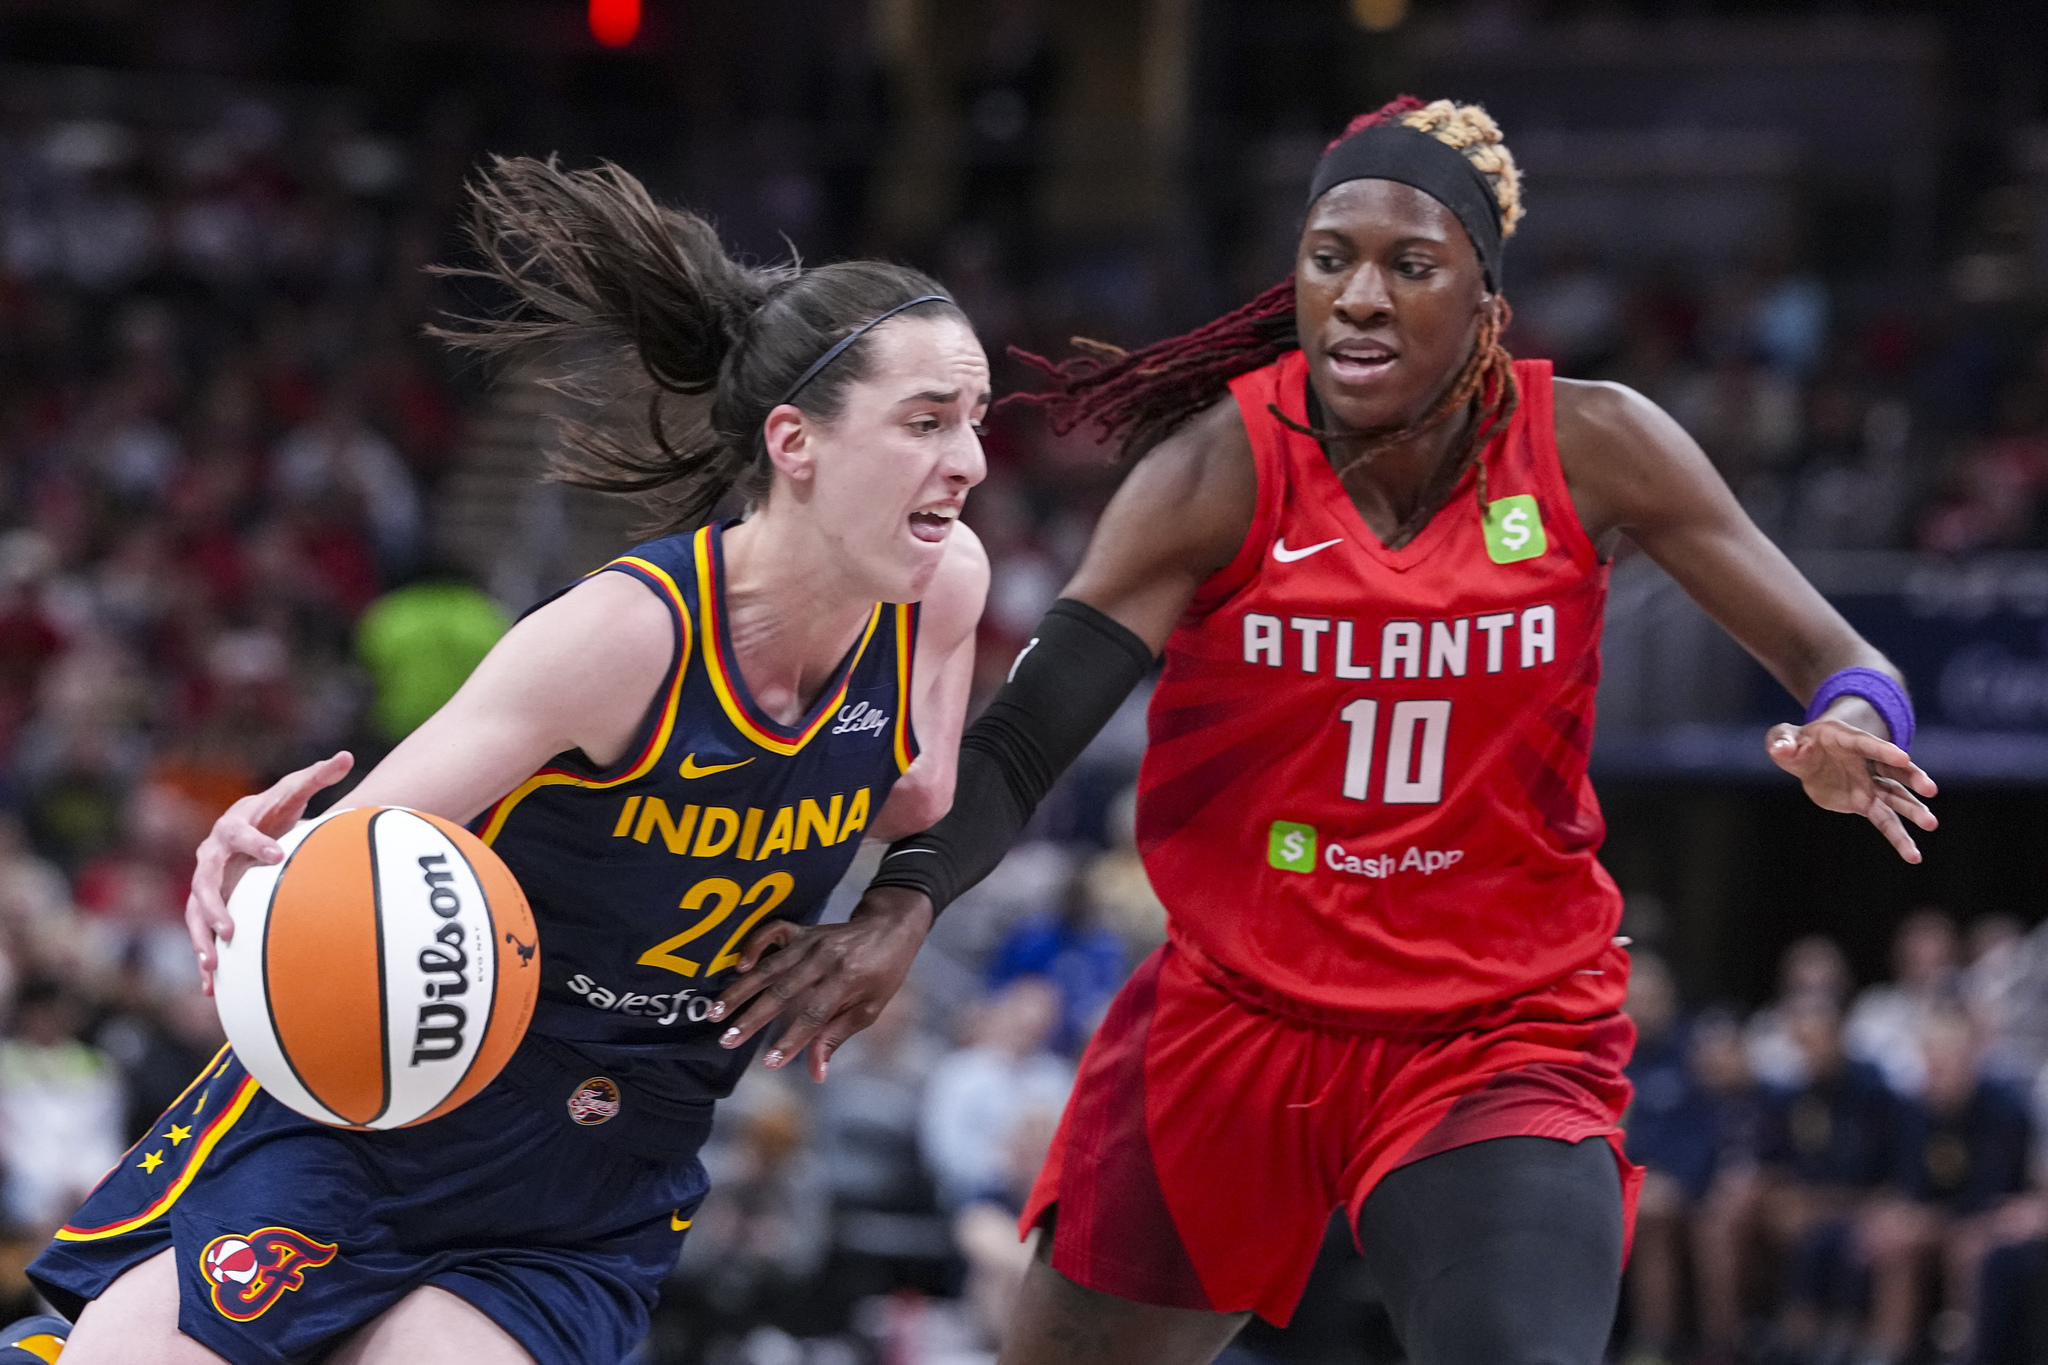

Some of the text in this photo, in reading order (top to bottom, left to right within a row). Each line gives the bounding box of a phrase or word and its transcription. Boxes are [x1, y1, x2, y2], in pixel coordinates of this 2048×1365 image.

[1243, 603, 1556, 680] ATLANTA
[832, 701, 888, 737] Lilly
[1340, 698, 1453, 804] 10
[612, 786, 871, 861] INDIANA
[1324, 843, 1396, 879] Cash
[1398, 846, 1464, 875] App
[409, 853, 469, 1067] Wilson
[636, 871, 795, 978] 22
[566, 973, 714, 1025] salesfo
